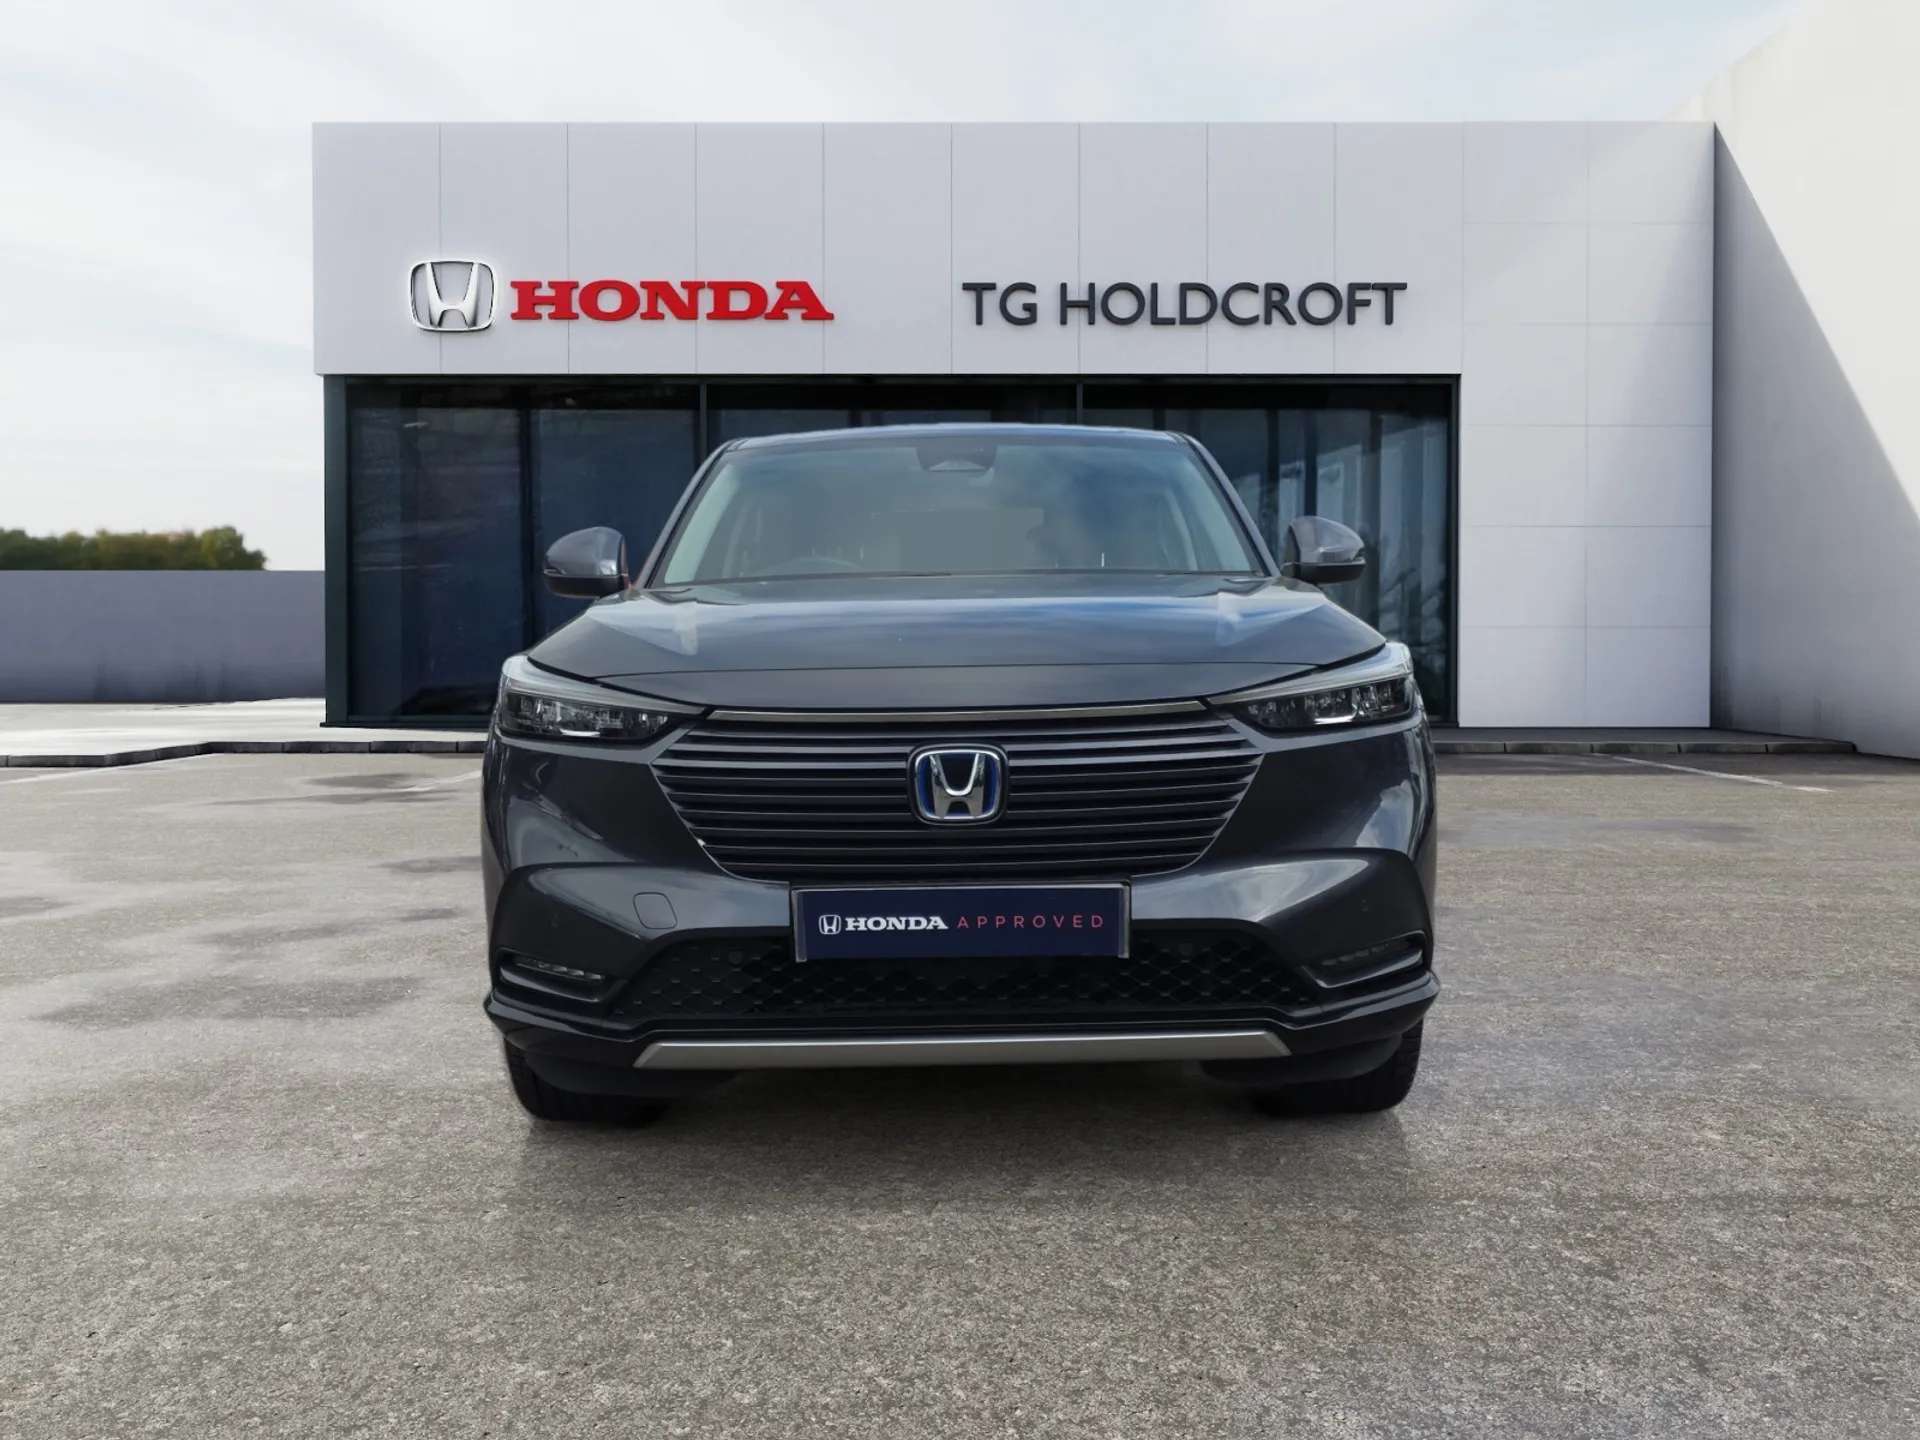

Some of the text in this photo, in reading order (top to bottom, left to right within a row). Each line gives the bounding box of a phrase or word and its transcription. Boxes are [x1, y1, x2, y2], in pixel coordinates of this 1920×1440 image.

[510, 280, 834, 321] HONDA
[962, 281, 1408, 325] TG HOLDCROFT
[845, 916, 948, 931] HONDA
[957, 915, 1103, 929] APPROVED
